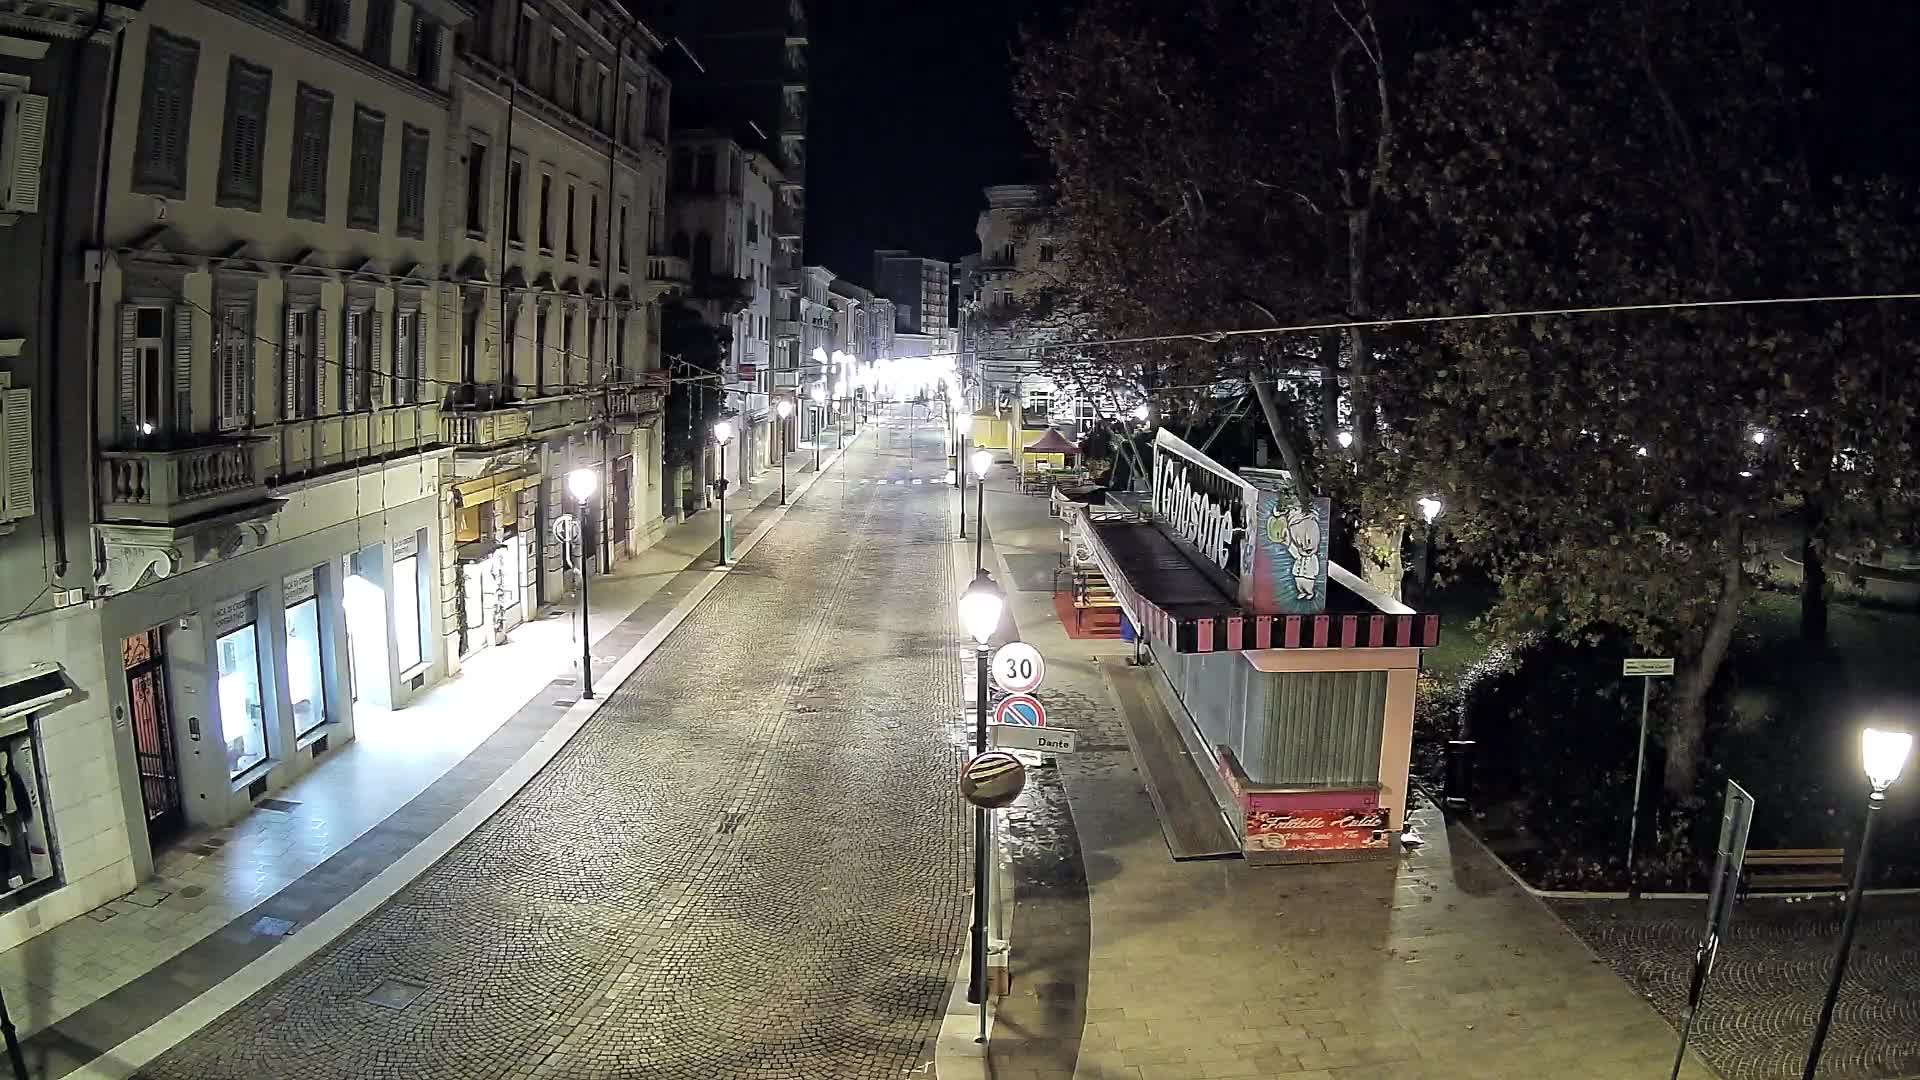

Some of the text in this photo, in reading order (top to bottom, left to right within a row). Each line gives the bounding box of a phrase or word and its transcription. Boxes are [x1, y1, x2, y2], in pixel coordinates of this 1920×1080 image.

[1160, 457, 1232, 570] Golosone
[1006, 658, 1032, 679] 30
[1038, 737, 1069, 749] Dante
